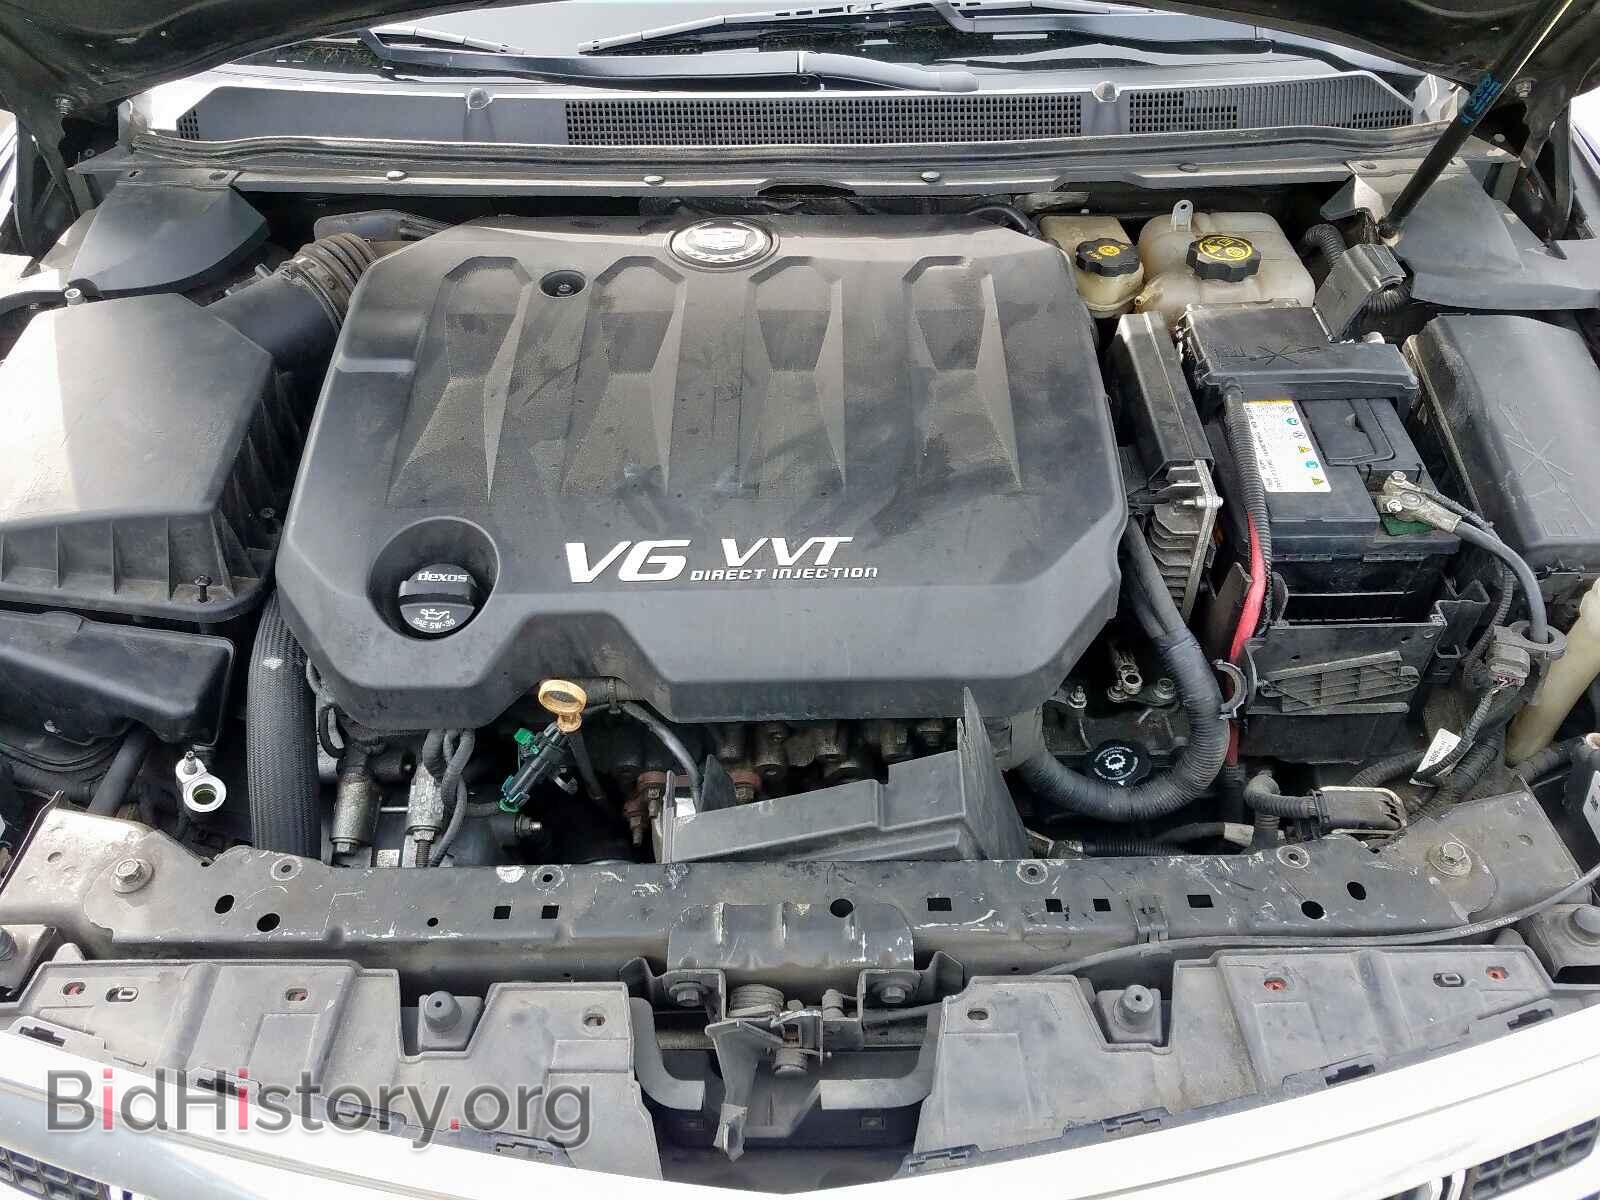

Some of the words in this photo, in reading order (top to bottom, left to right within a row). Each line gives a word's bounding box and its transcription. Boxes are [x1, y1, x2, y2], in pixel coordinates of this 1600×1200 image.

[565, 539, 691, 583] V6
[720, 536, 854, 567] VVT
[417, 571, 470, 583] dexos
[690, 568, 767, 581] DIRECT
[772, 567, 878, 580] INJECTION
[413, 617, 429, 628] SAE
[429, 618, 456, 629] 5W-30
